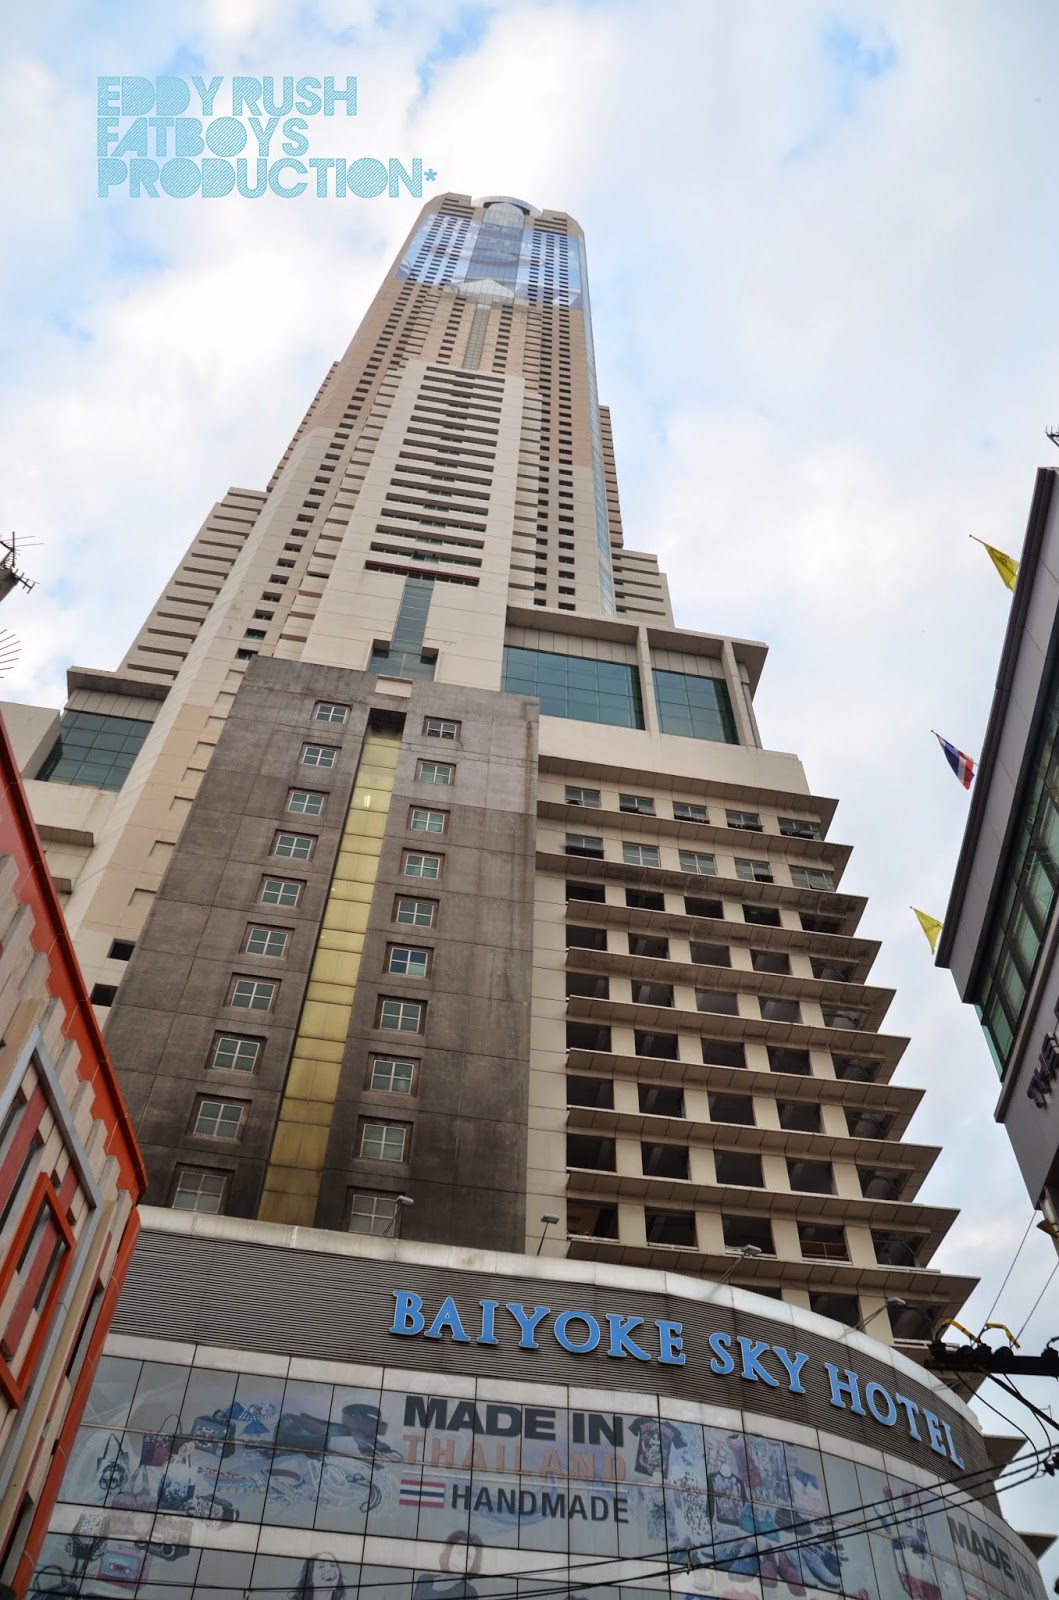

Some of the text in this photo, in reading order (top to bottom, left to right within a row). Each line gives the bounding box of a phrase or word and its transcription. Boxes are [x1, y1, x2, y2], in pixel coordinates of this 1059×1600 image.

[389, 1289, 965, 1470] BAIYOKE SKY HOTEL
[403, 1395, 624, 1448] MADE IN
[402, 1434, 627, 1483] THAILAND
[451, 1484, 629, 1523] HANDMADE
[948, 1516, 1016, 1583] MADE
